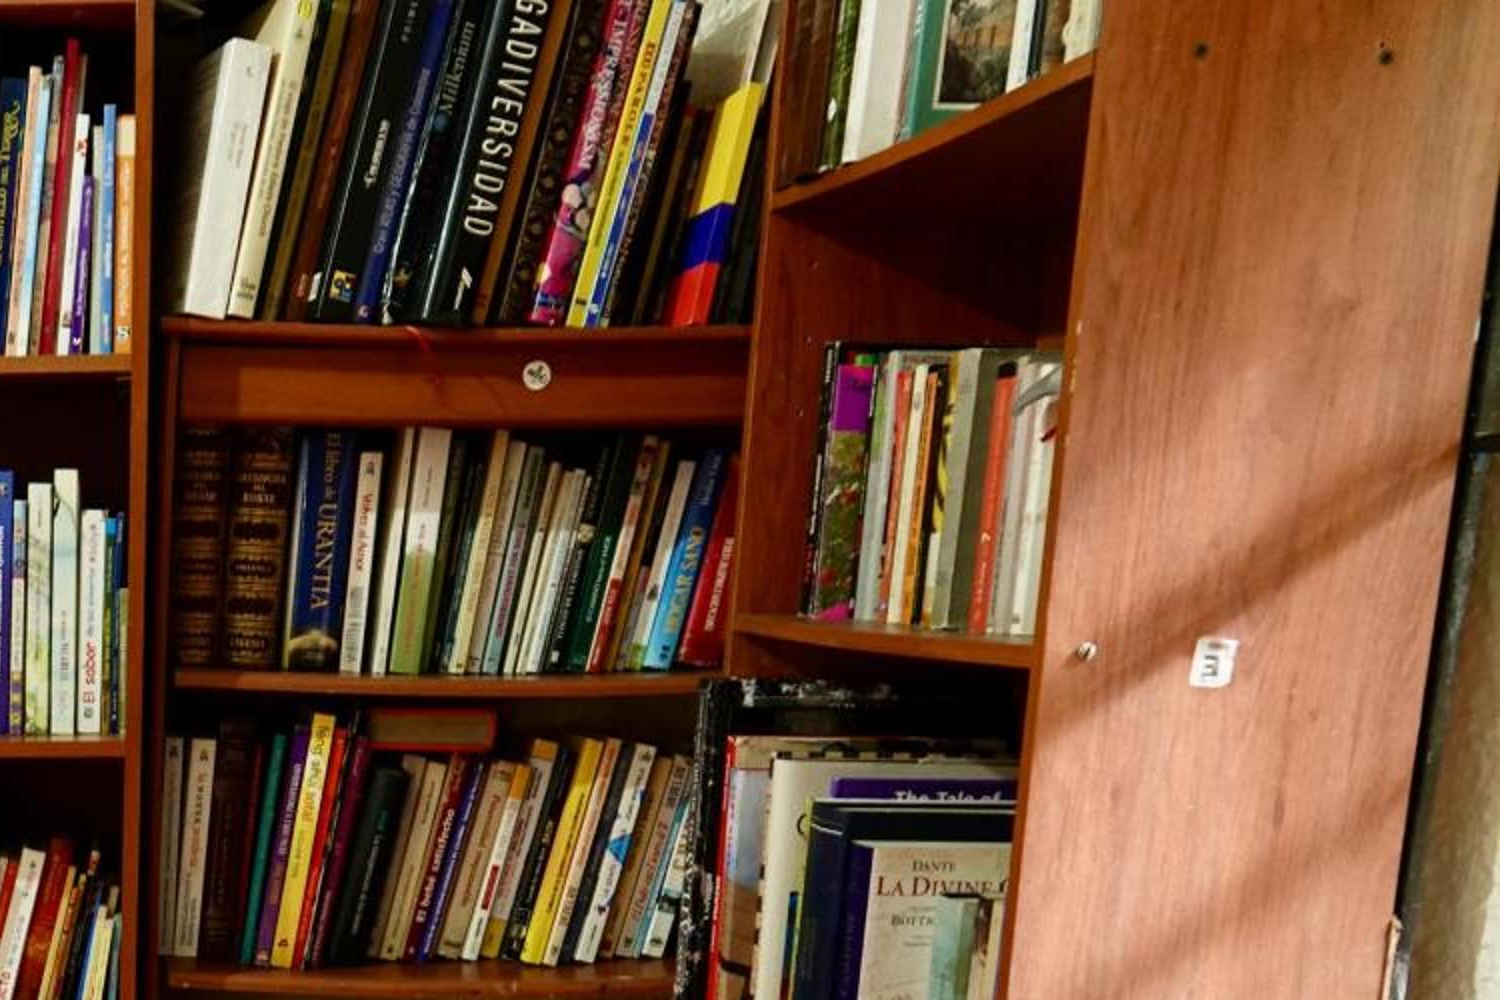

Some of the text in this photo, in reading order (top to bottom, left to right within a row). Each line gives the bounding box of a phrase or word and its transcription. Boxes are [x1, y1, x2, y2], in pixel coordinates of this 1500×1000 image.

[322, 449, 341, 483] libro
[309, 503, 338, 610] URANTIA
[82, 641, 97, 686] sabor
[82, 690, 96, 705] El
[912, 860, 958, 872] DANTE
[877, 876, 994, 897] LA DIVINE
